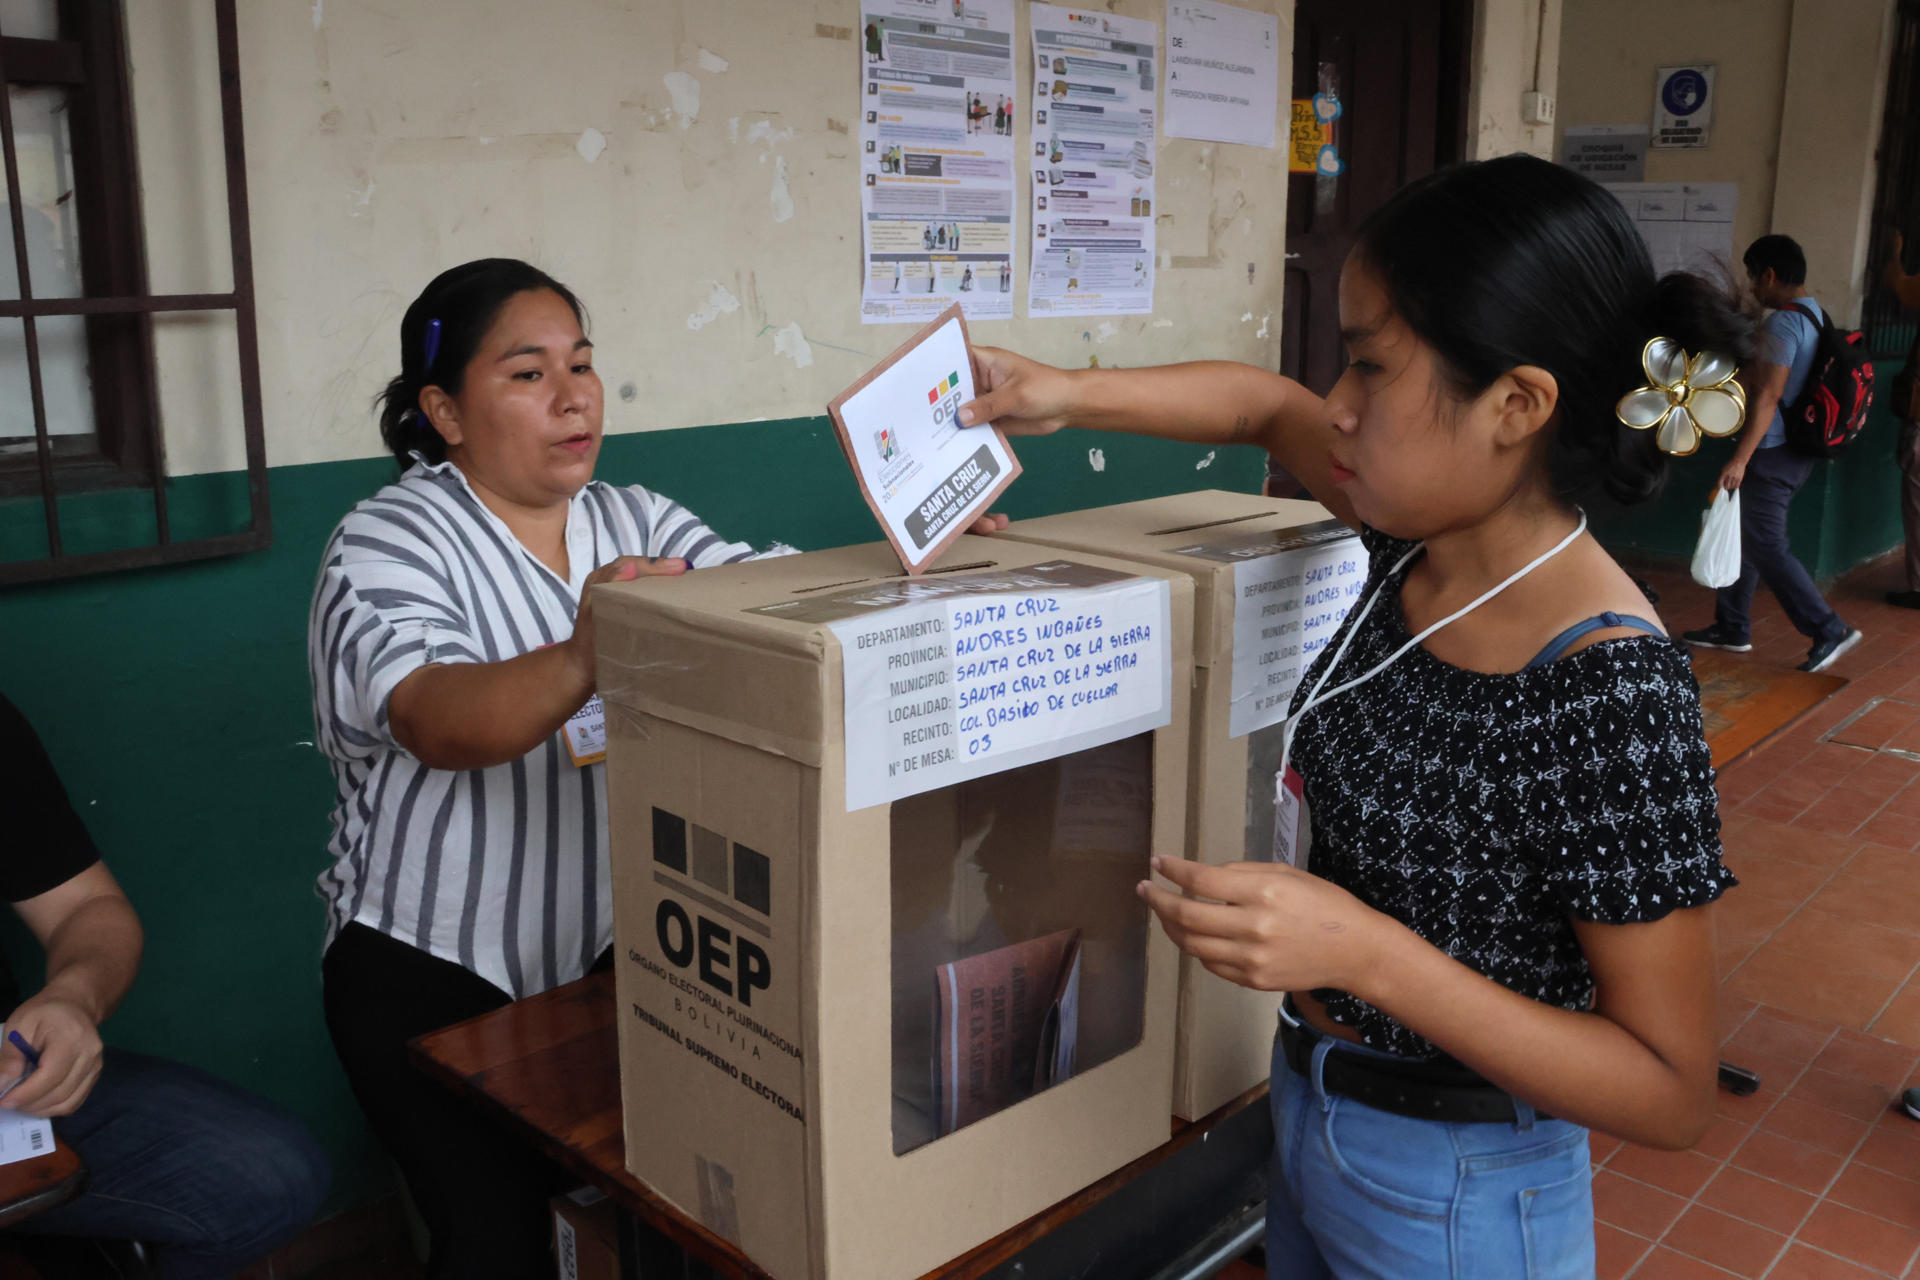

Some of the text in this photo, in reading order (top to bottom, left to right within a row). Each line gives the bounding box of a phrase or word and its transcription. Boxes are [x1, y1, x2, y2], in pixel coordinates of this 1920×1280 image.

[933, 391, 962, 425] OEP
[920, 458, 982, 522] SANTA CRUZ
[924, 470, 992, 538] SANTA CRUZ DE LA SIERRA
[1305, 561, 1356, 585] SANTA CRUZ
[1304, 586, 1340, 607] ANDRES
[953, 598, 1061, 631] SANTA CRUZ
[1304, 613, 1332, 631] SANTA
[857, 619, 945, 649] DEPARTAMENTO:
[956, 627, 1028, 657] ANDRES
[888, 645, 948, 670] PROVINCIA:
[956, 625, 1151, 682] SANTA CRUZ DE LA SIERRA
[890, 671, 949, 697] MUNICIPIO:
[958, 652, 1137, 709] SANTA CRUZ DE LA SIERRA
[889, 697, 952, 724] LOCALIDAD:
[960, 715, 983, 732] COL.
[1047, 694, 1065, 711] DE
[1071, 682, 1118, 707] CUELLAR
[903, 722, 953, 746] RECINTO:
[968, 733, 992, 755] 03
[889, 748, 955, 777] N° DE MESA:
[655, 899, 771, 1008] OEP
[668, 973, 725, 1014] ELECTORAL
[727, 1005, 804, 1065] PLURINACIONA
[674, 997, 761, 1060] BOLIVIA
[632, 1002, 806, 1126] TRIBUNAL SUPREMO ELECTORA
